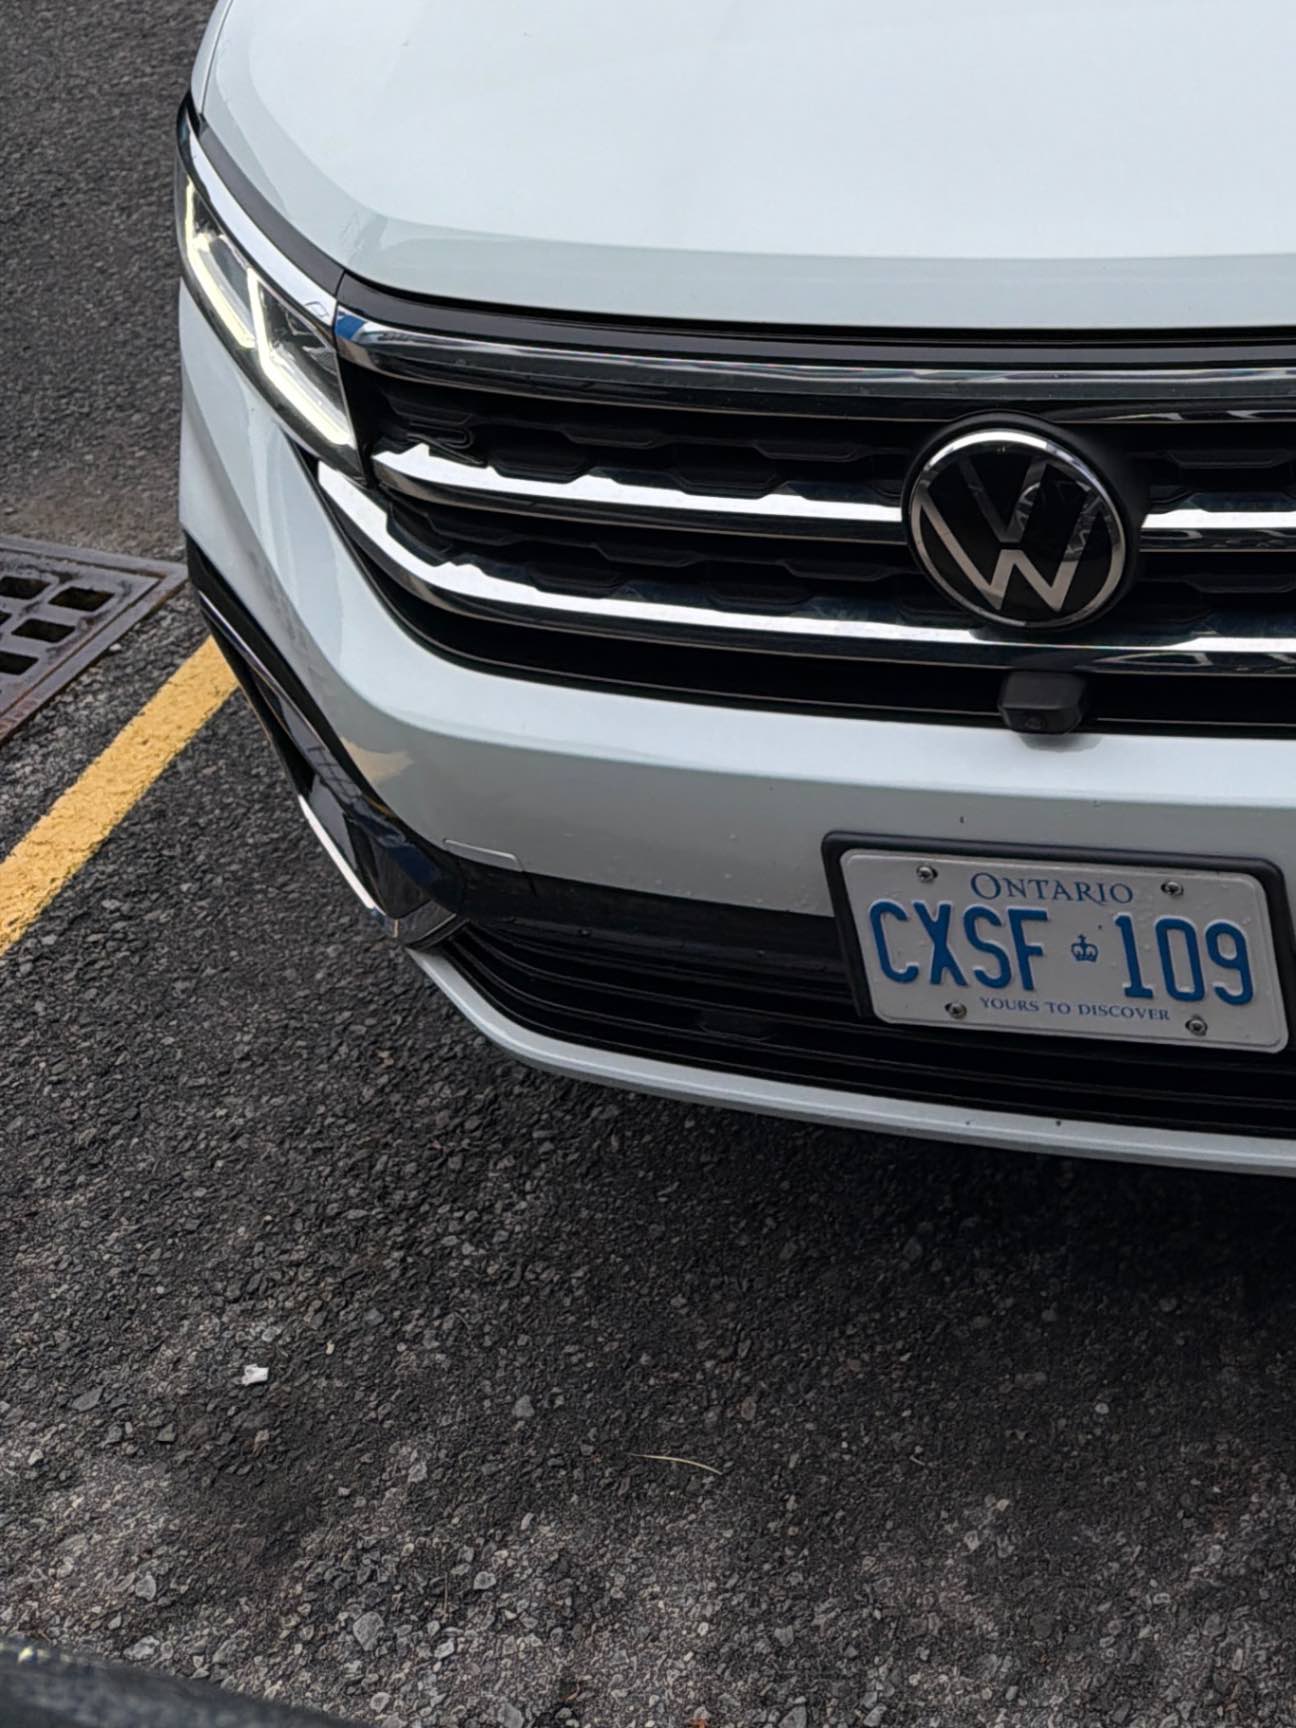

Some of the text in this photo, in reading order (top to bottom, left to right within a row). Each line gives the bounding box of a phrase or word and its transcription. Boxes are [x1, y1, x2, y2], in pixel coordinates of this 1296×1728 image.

[867, 898, 1255, 1006] CXSF 109
[979, 995, 1171, 1022] YOURS TO DISCOVER
